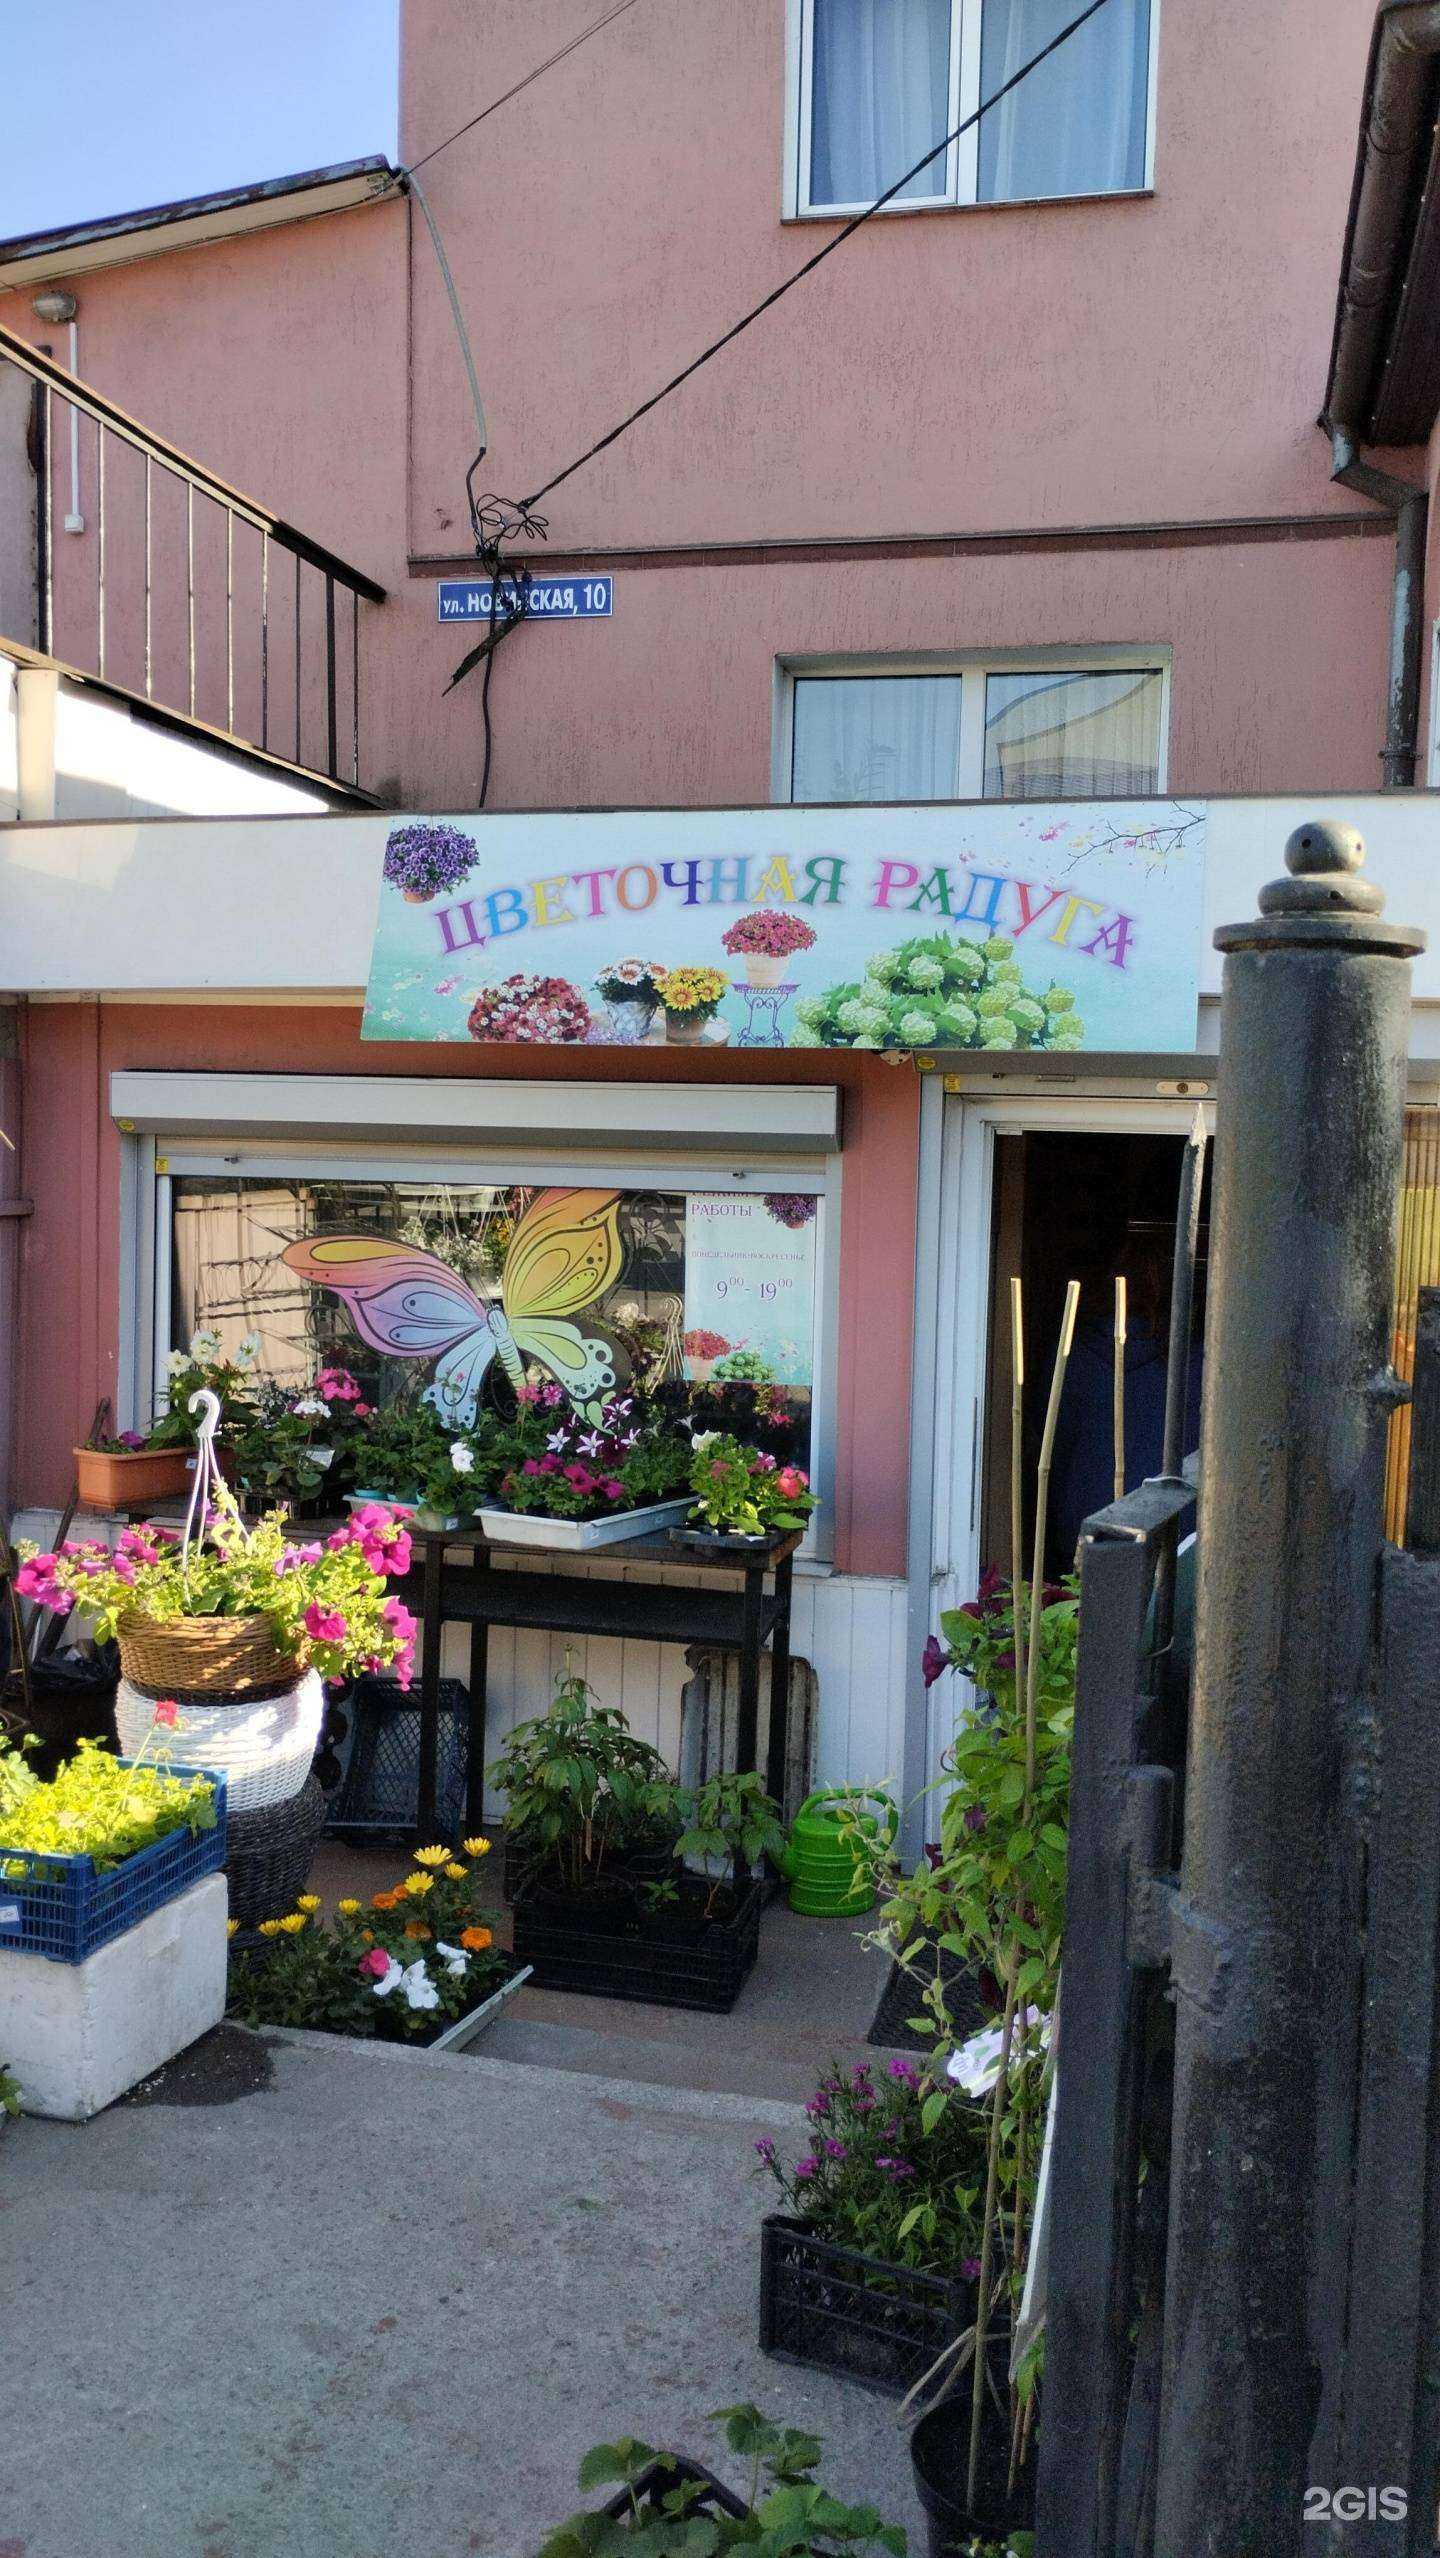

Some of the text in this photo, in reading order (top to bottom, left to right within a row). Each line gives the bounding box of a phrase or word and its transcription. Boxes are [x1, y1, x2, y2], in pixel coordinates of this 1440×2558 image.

[442, 600, 464, 614] ул.
[584, 584, 606, 609] 10
[435, 854, 1134, 969] ЦВЕТОЧНАЯ РАДУГА
[691, 1204, 752, 1217] РАБОТЫ
